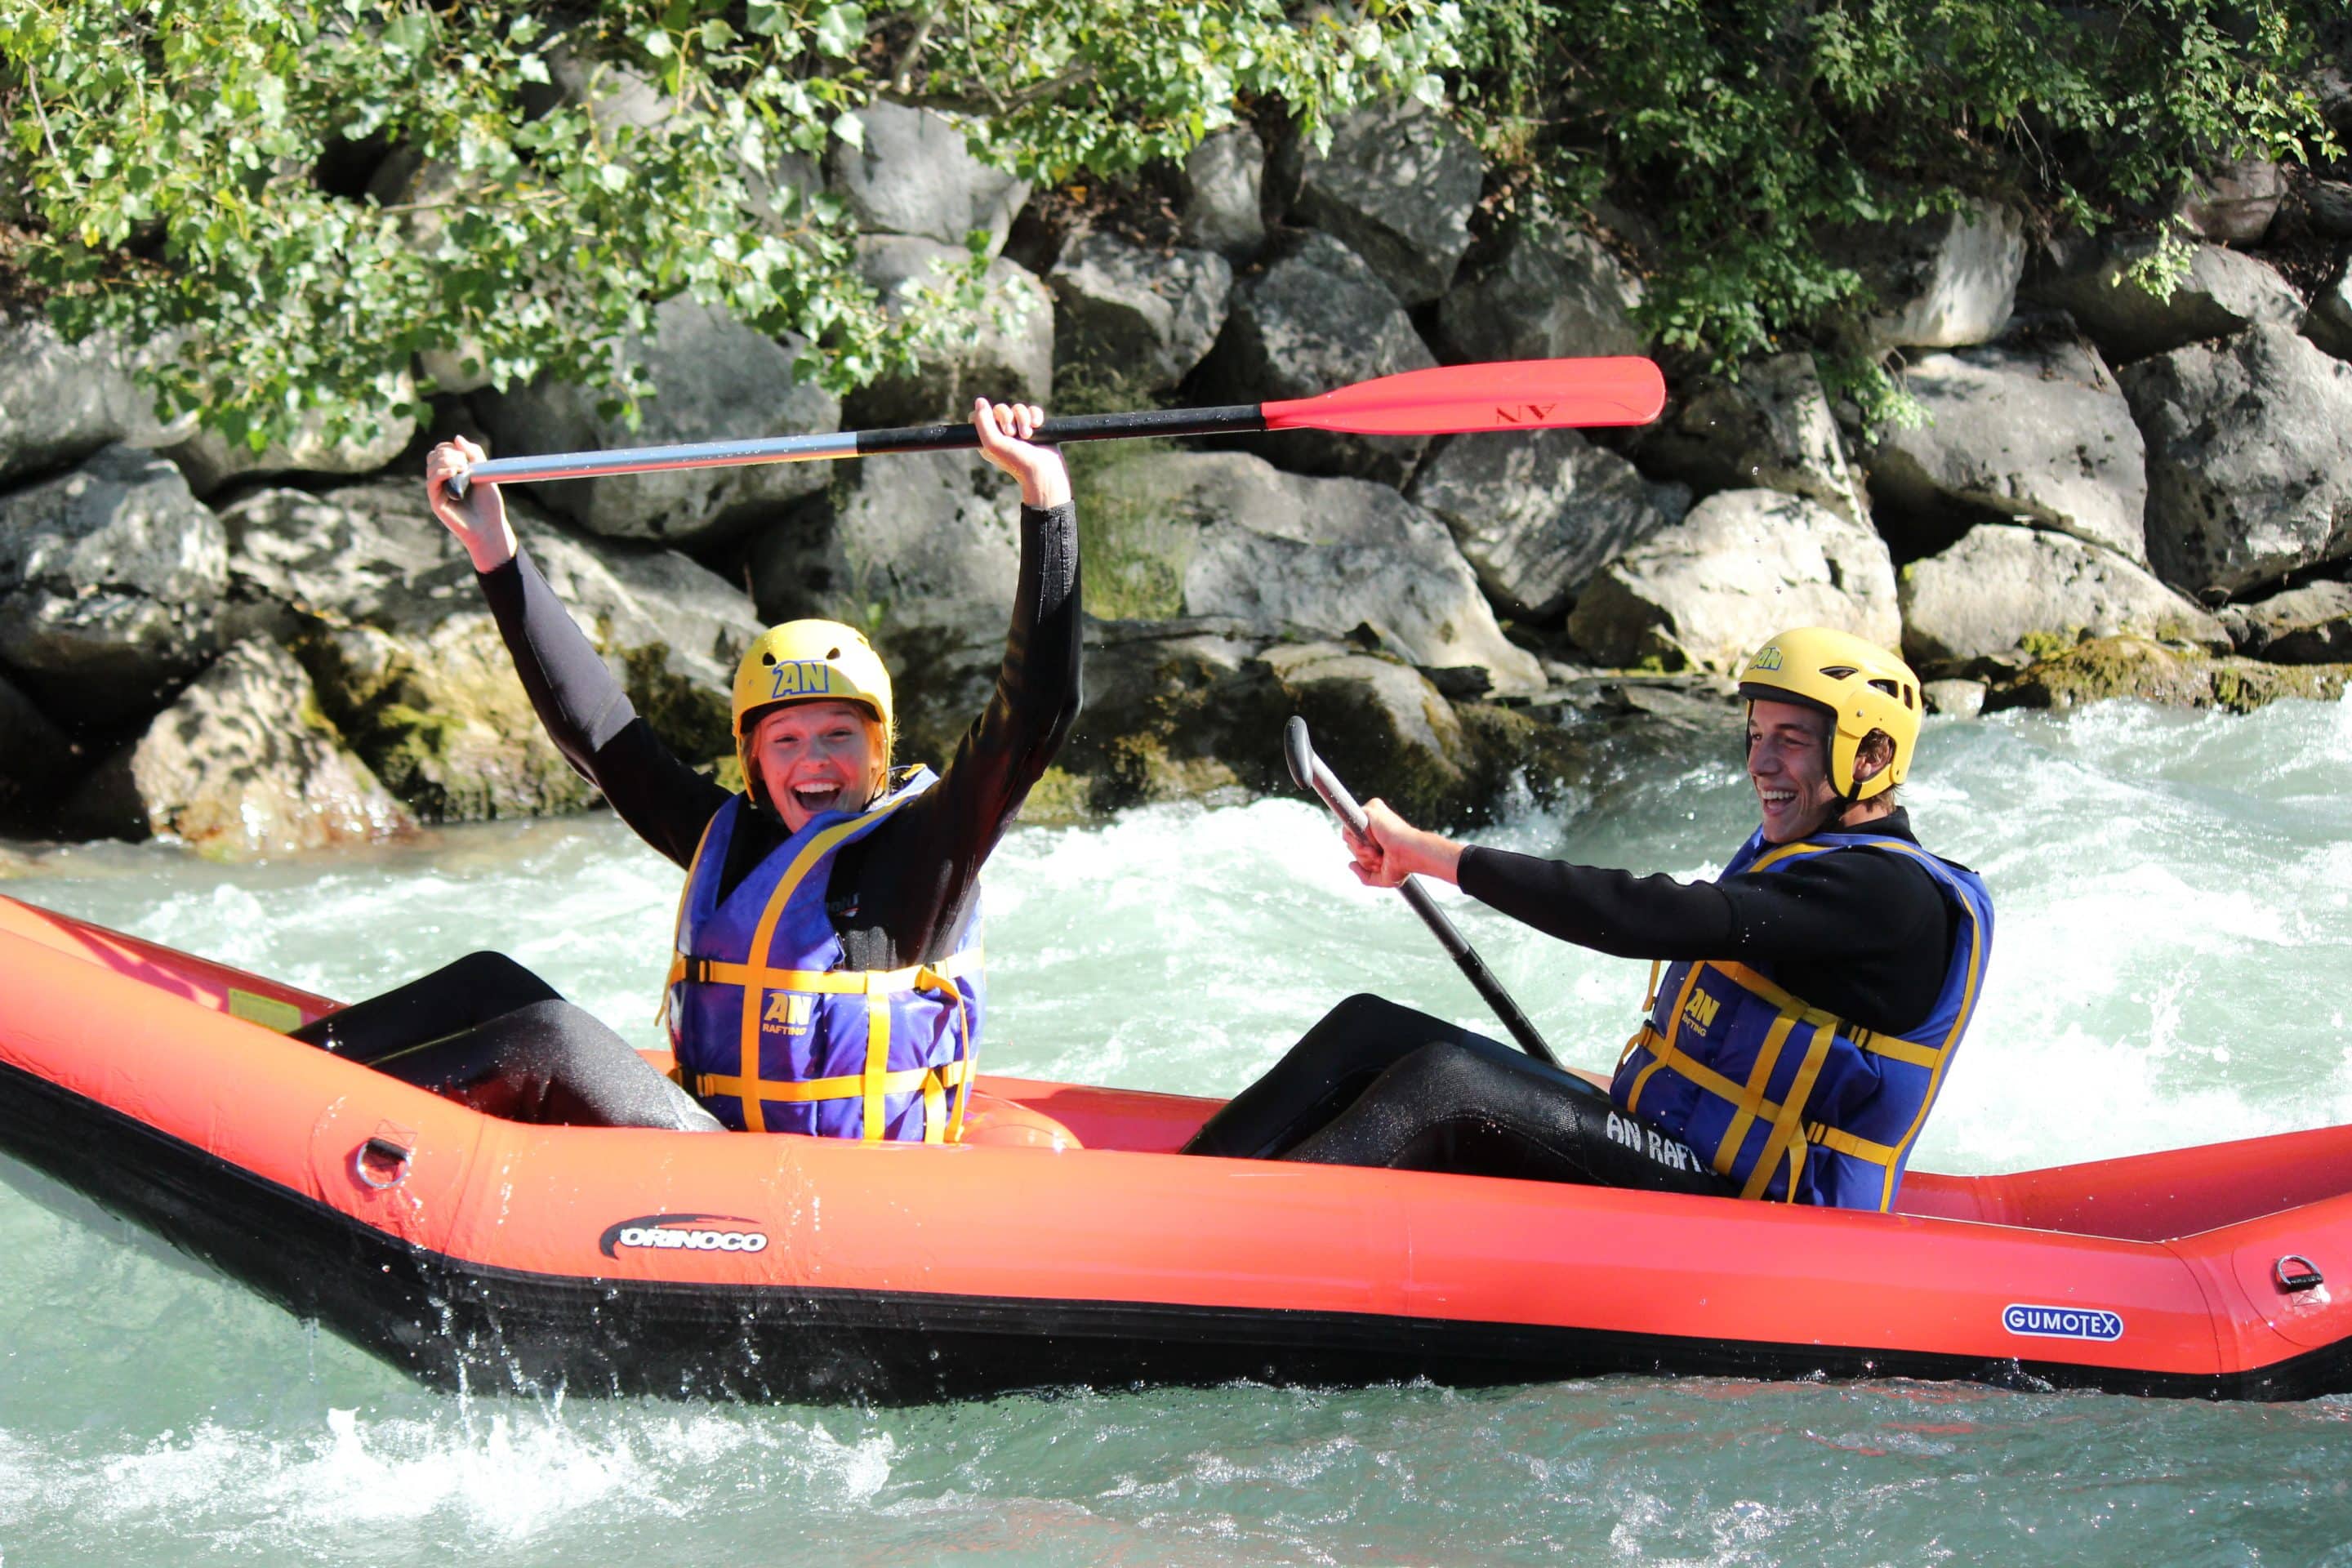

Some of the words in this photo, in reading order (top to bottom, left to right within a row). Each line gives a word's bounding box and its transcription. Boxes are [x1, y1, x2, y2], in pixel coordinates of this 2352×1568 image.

[1749, 647, 1784, 671] AN
[772, 659, 830, 698] AN
[764, 992, 813, 1026] AN
[1685, 987, 1721, 1027] AN
[762, 1022, 808, 1036] RAFTING
[1606, 1111, 1642, 1152] AN
[1647, 1129, 1718, 1176] RAFT
[620, 1227, 768, 1252] ORINOCO
[2009, 1310, 2117, 1336] GUMOTEX
